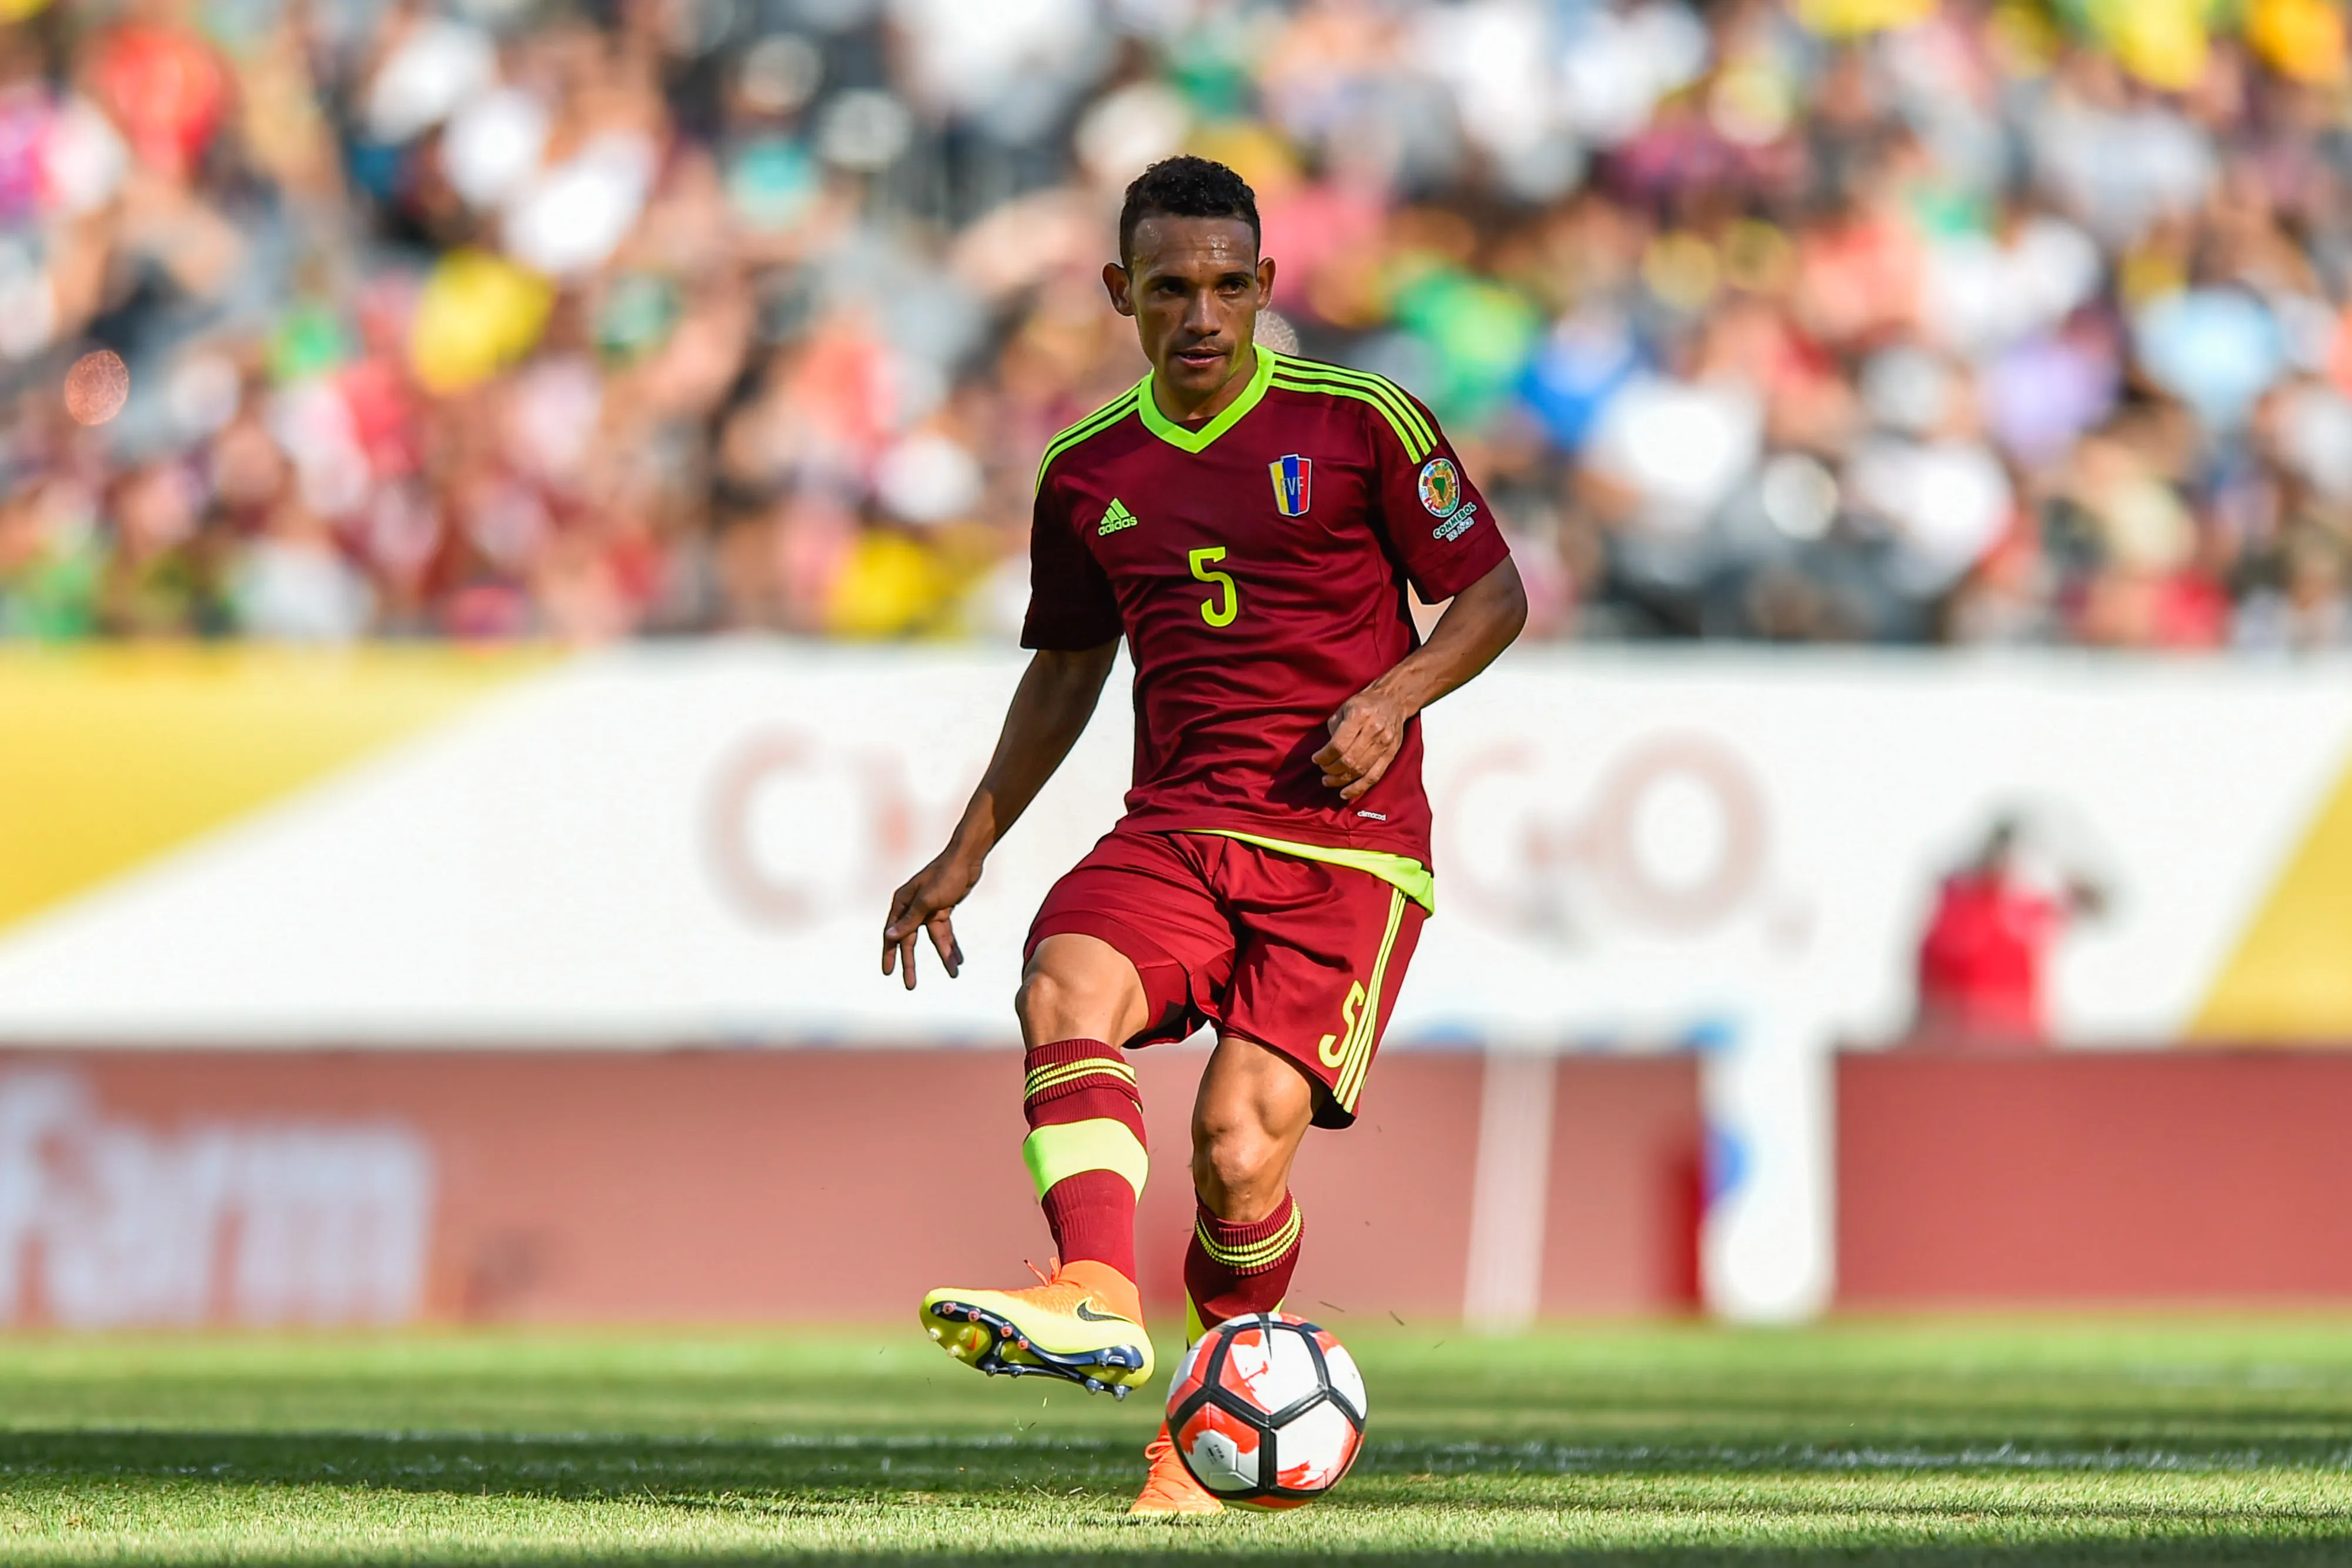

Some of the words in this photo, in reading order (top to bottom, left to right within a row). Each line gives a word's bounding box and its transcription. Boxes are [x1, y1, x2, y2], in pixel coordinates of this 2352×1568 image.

[1280, 476, 1304, 496] FVF
[1098, 516, 1138, 536] adidas
[1433, 502, 1476, 538] CONMEBOL
[1189, 546, 1237, 627] 5
